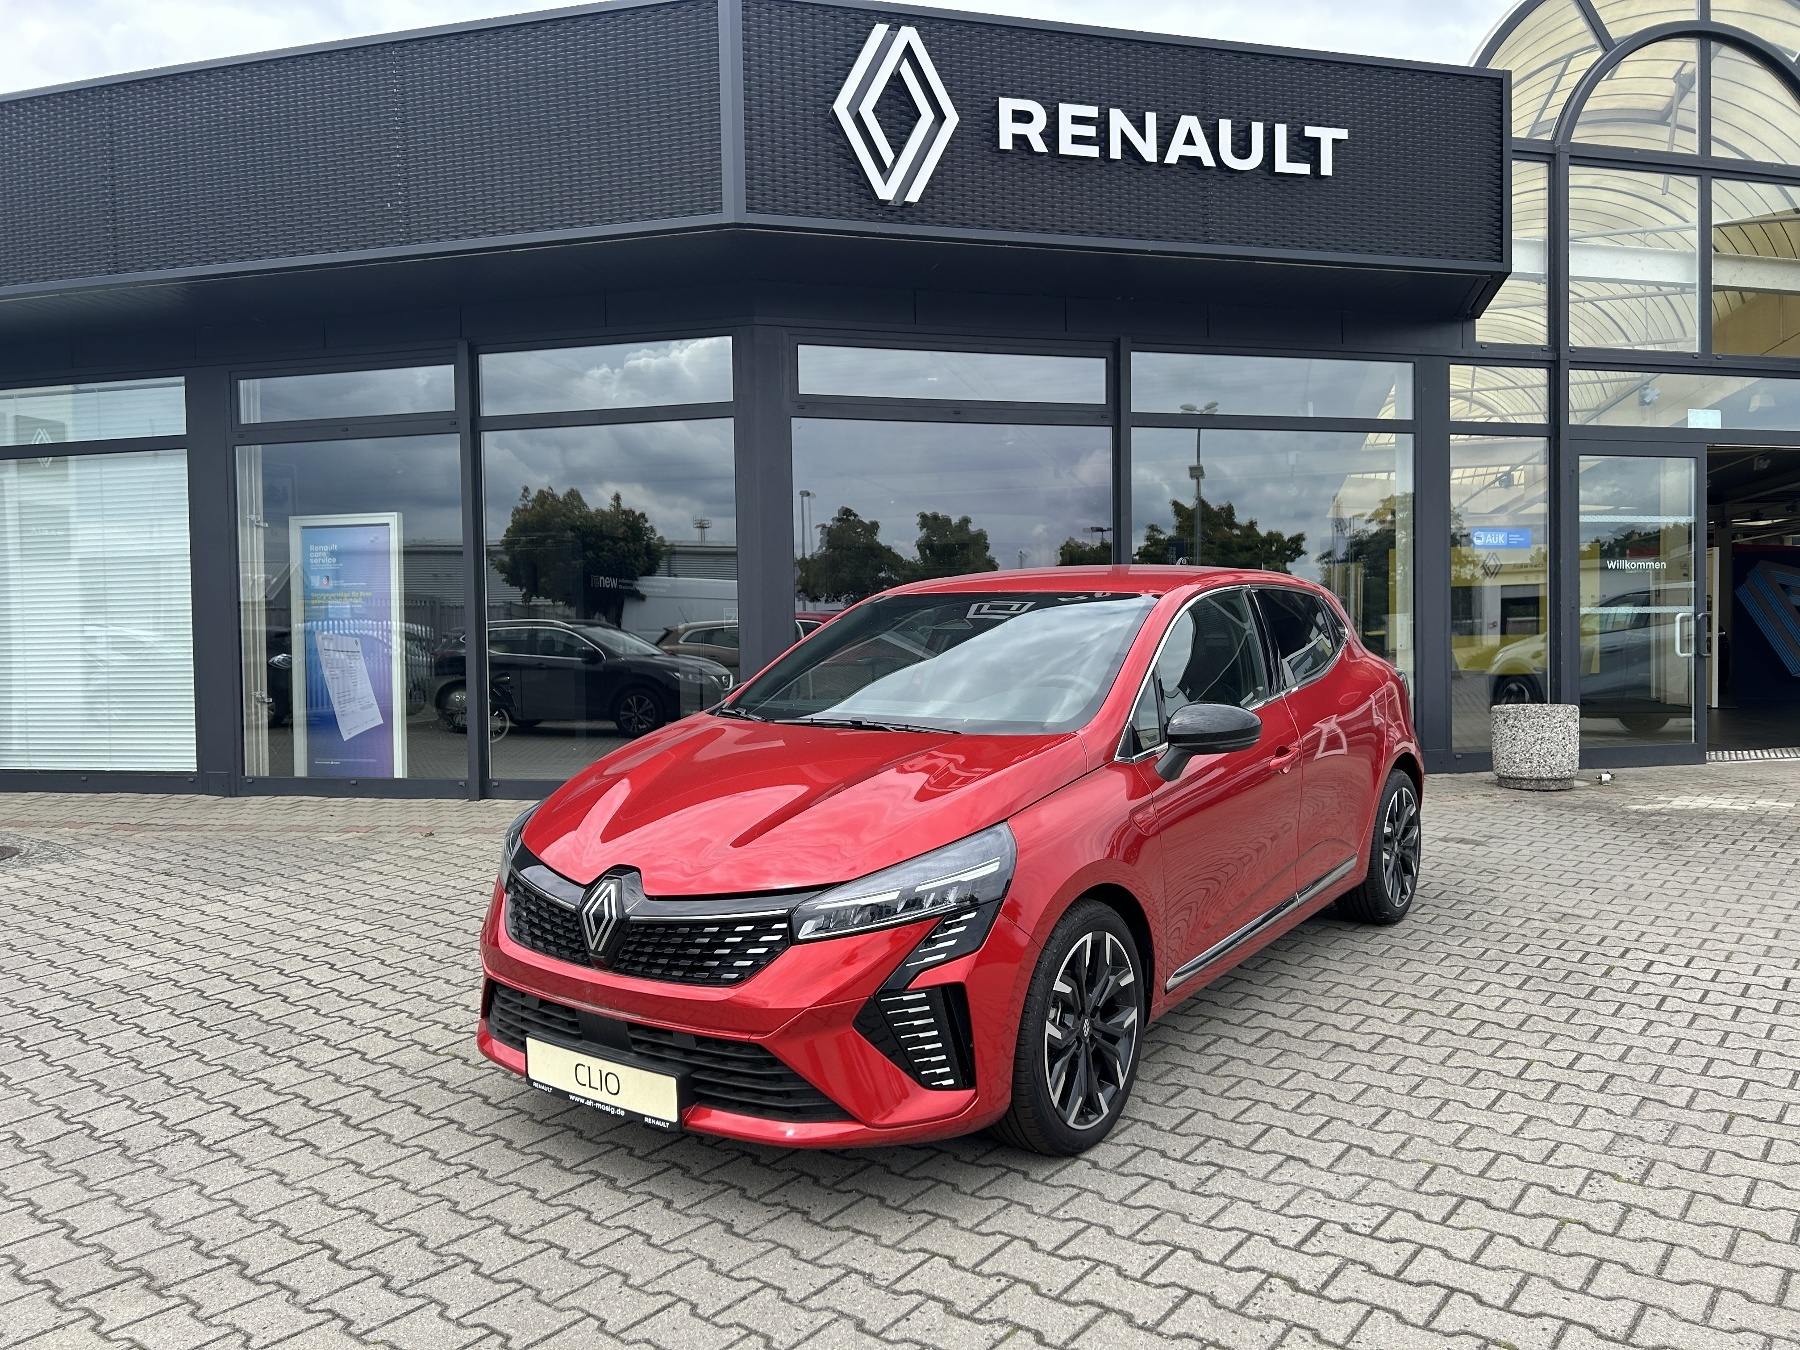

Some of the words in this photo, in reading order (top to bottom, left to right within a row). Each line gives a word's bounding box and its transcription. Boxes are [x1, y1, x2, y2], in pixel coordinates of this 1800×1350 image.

[998, 97, 1349, 176] RENAULT
[1606, 559, 1667, 570] Willkommen
[532, 1081, 553, 1093] RENAULT
[574, 1063, 620, 1096] CLIO
[568, 1094, 625, 1117] www.ah-mosig.de
[644, 1117, 670, 1129] RENAULT
